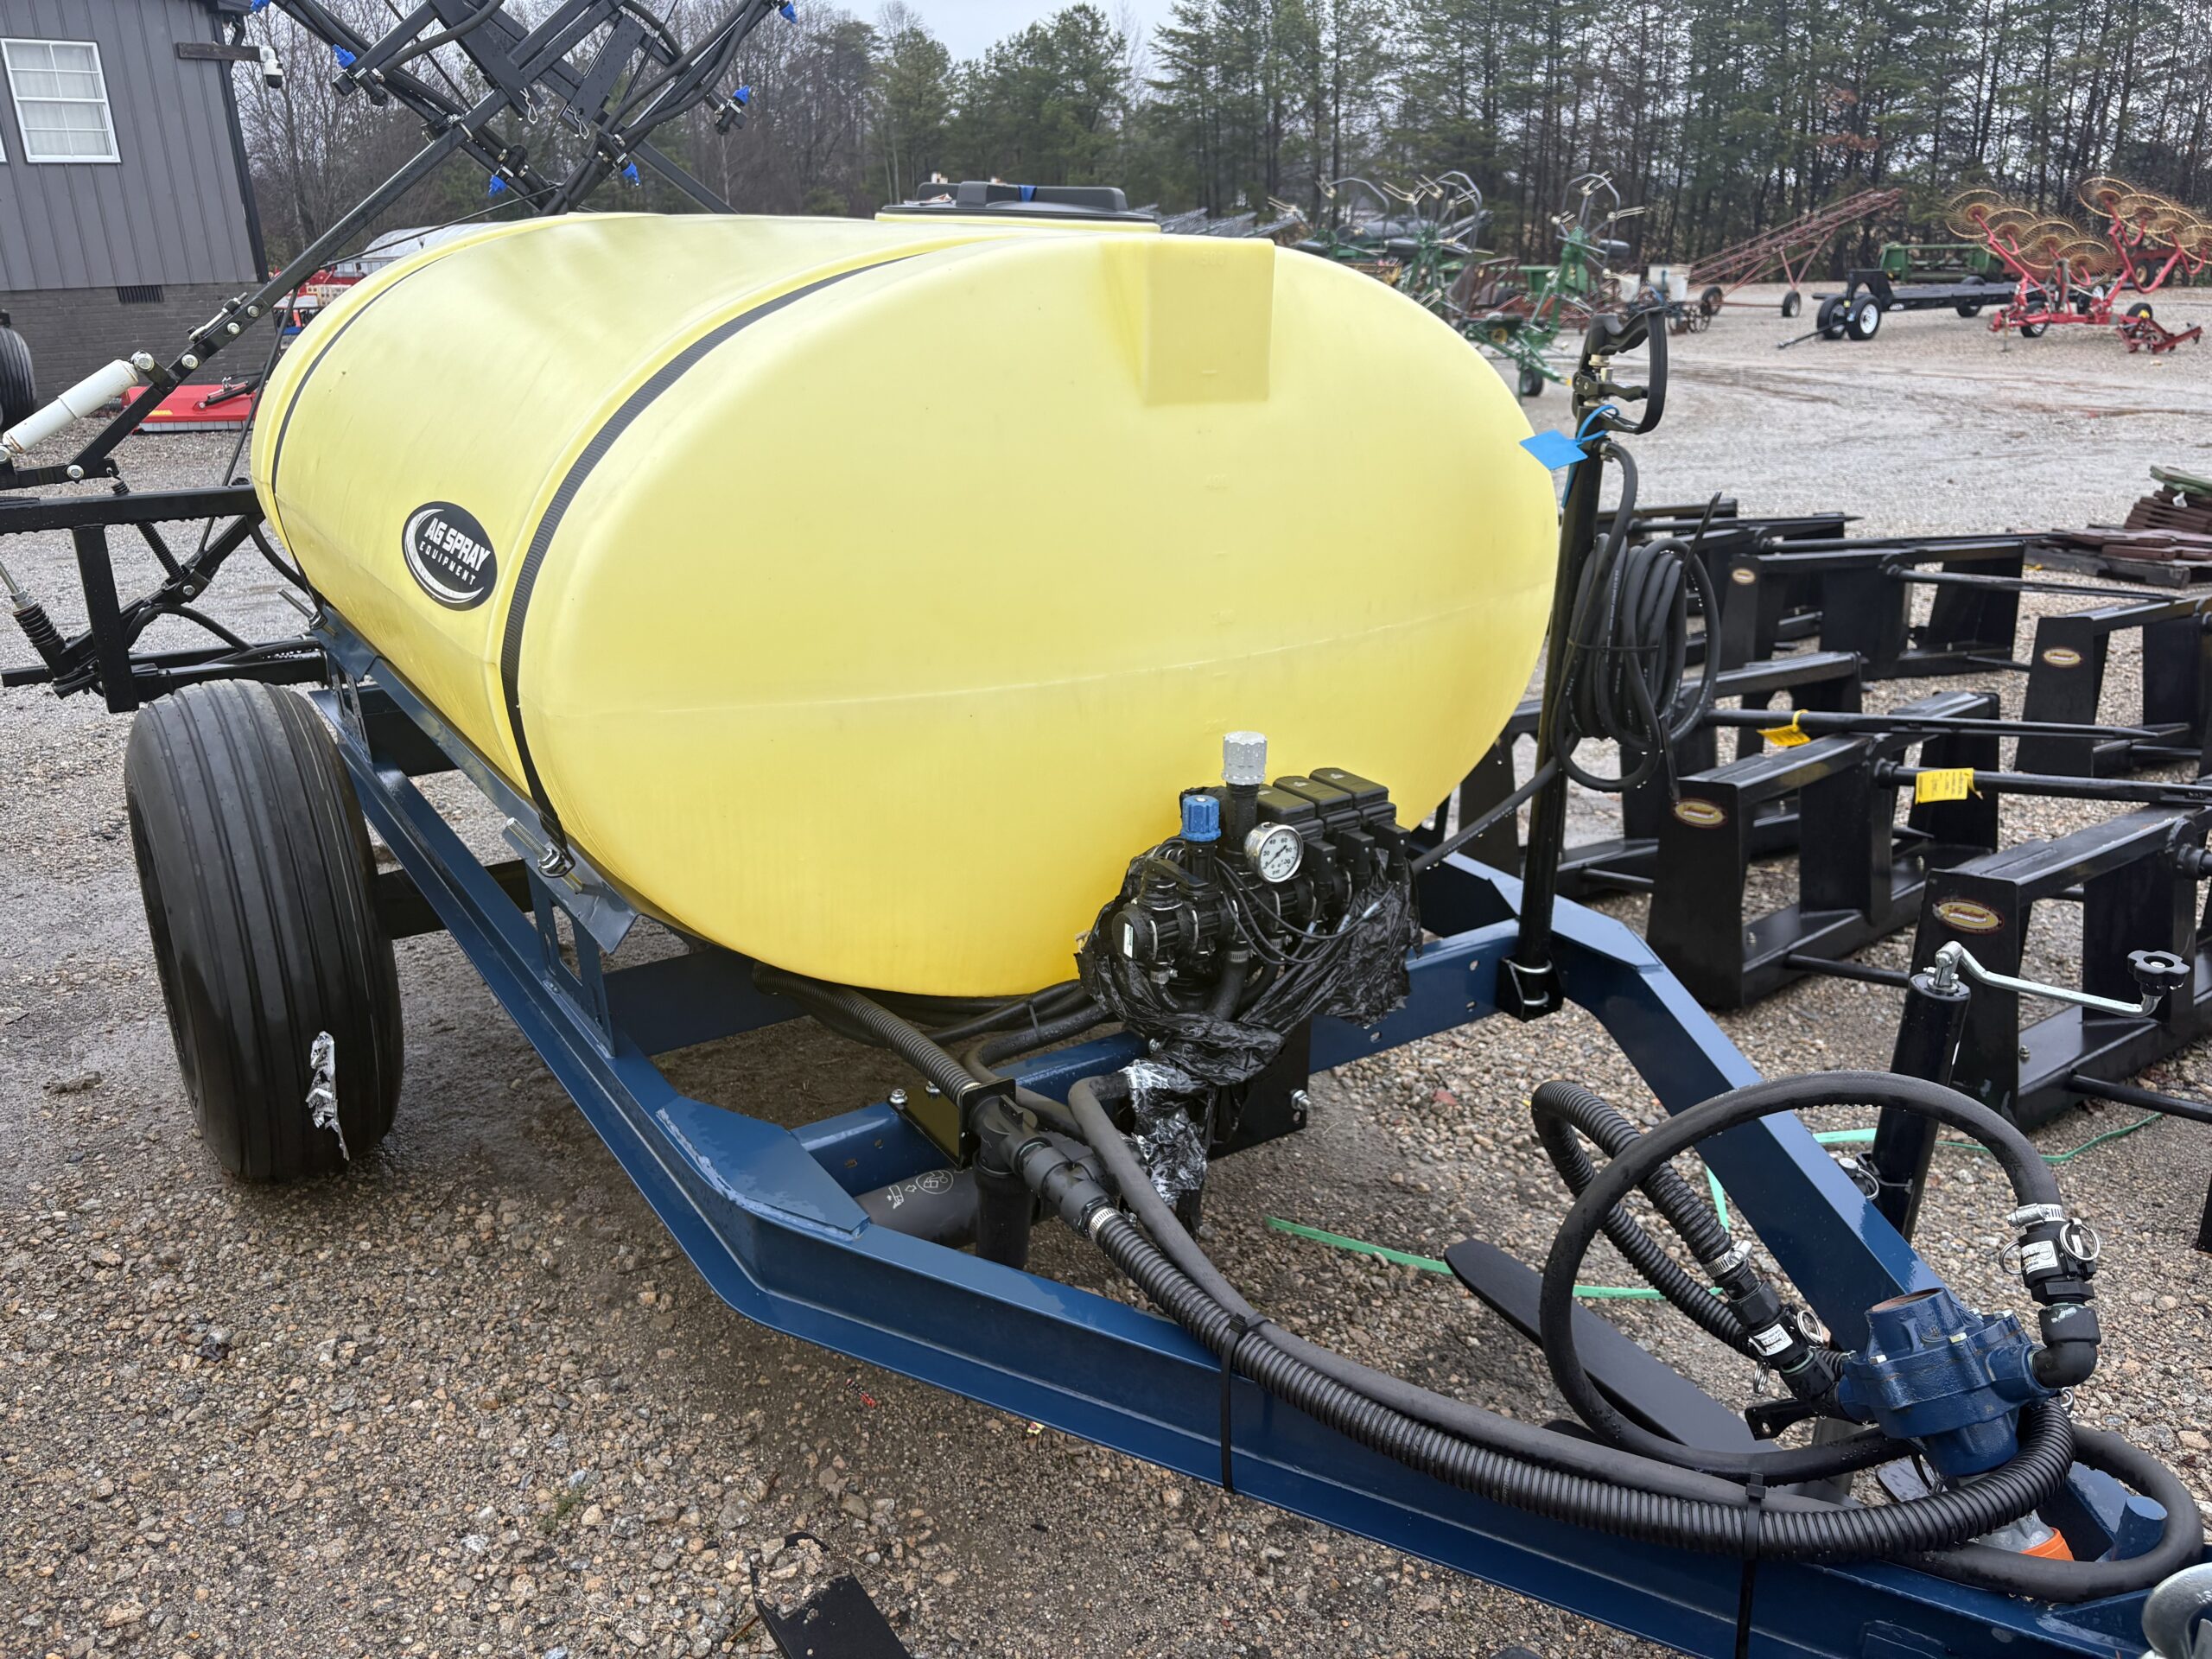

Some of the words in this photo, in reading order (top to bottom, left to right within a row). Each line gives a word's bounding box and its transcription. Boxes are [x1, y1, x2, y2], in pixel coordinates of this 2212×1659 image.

[419, 540, 476, 585] EQUIPMENT
[424, 518, 448, 545] AG
[442, 527, 491, 572] SPRAY
